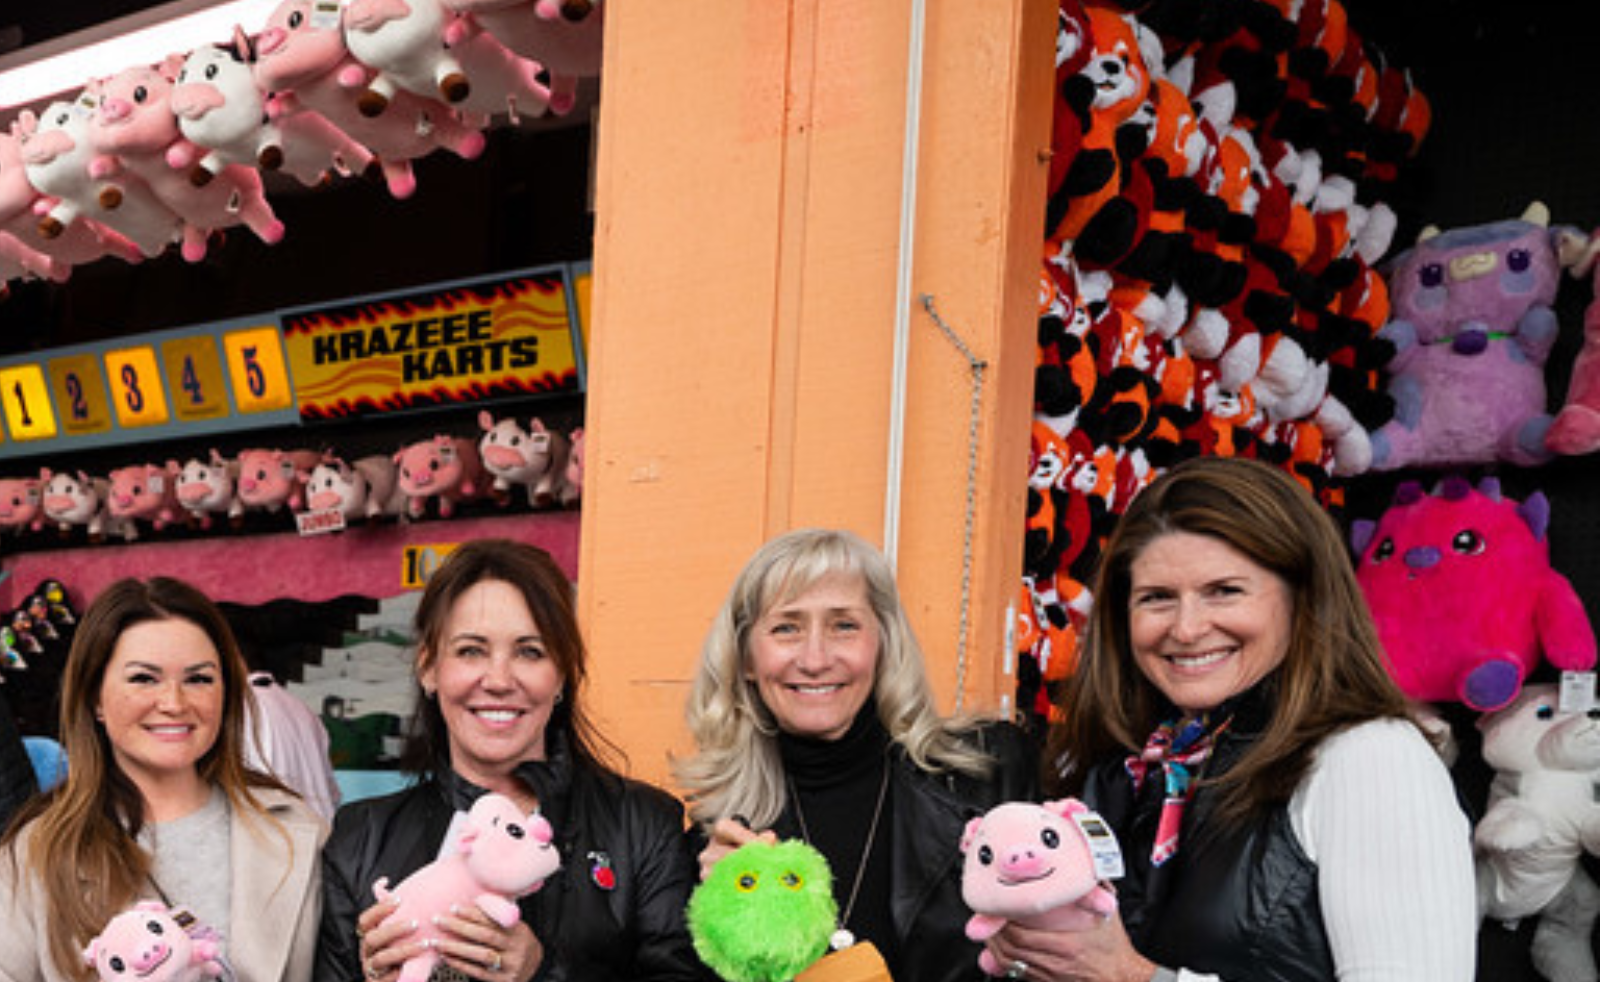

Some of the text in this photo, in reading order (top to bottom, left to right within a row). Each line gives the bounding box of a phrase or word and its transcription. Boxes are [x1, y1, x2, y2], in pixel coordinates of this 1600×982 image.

[313, 310, 492, 365] KRAZEEE
[403, 336, 538, 383] KARTS
[13, 346, 266, 427] 1 2 3 4 5
